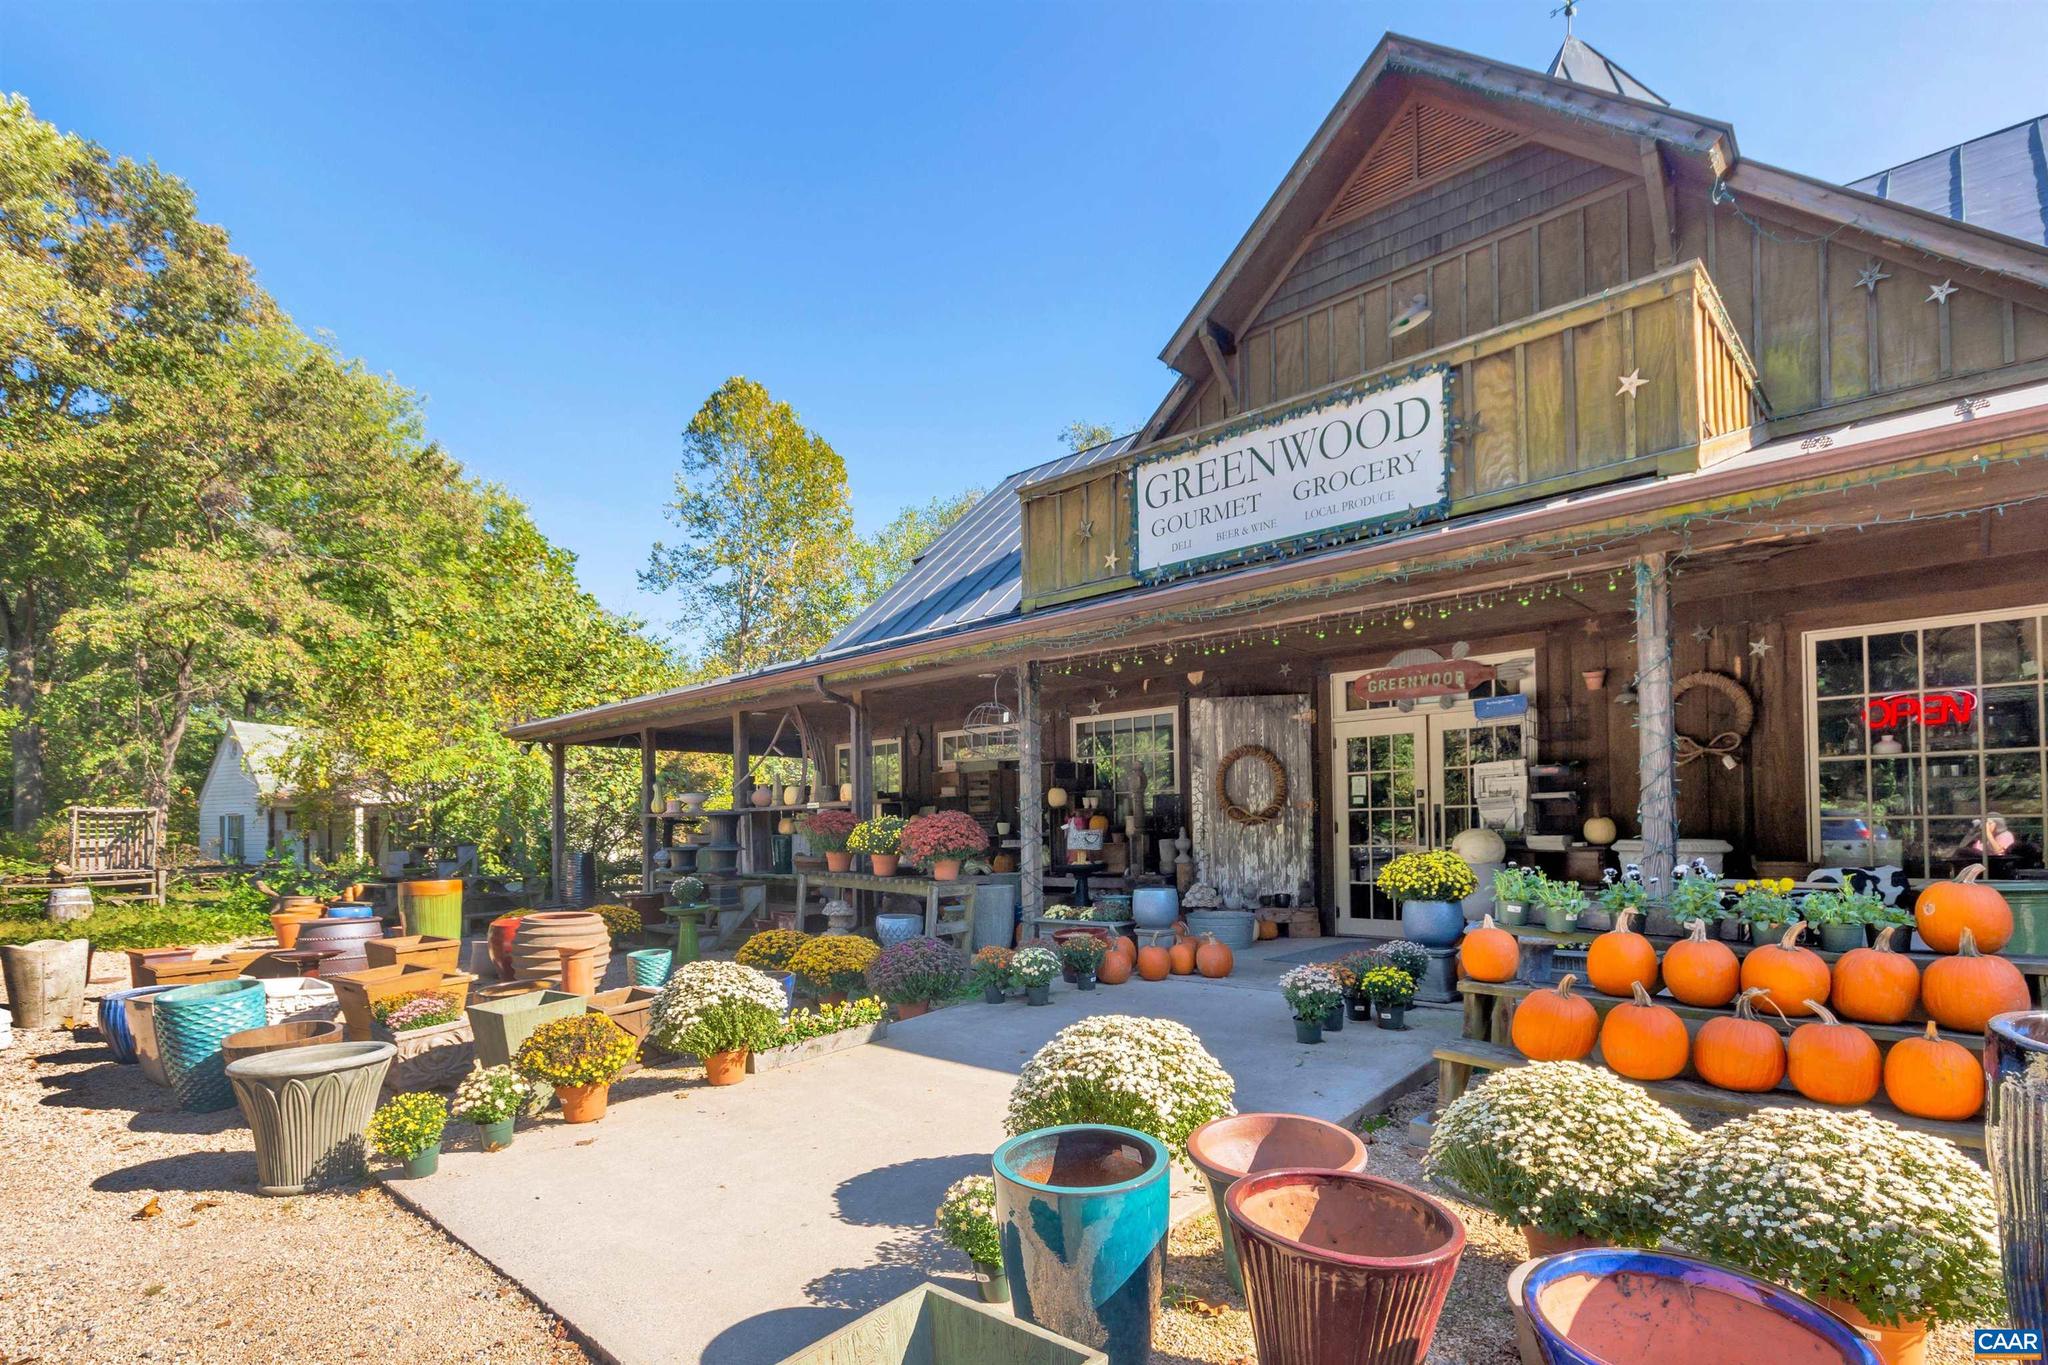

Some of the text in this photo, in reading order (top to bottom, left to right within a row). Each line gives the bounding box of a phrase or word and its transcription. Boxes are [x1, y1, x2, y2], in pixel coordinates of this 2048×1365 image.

[1144, 397, 1431, 509] GREENWOOD
[1151, 450, 1423, 538] GOURMET GROCERY
[1171, 490, 1395, 553] DELI BEER & WINE LOCAL PRODUCE
[1863, 694, 1972, 729] OPEN
